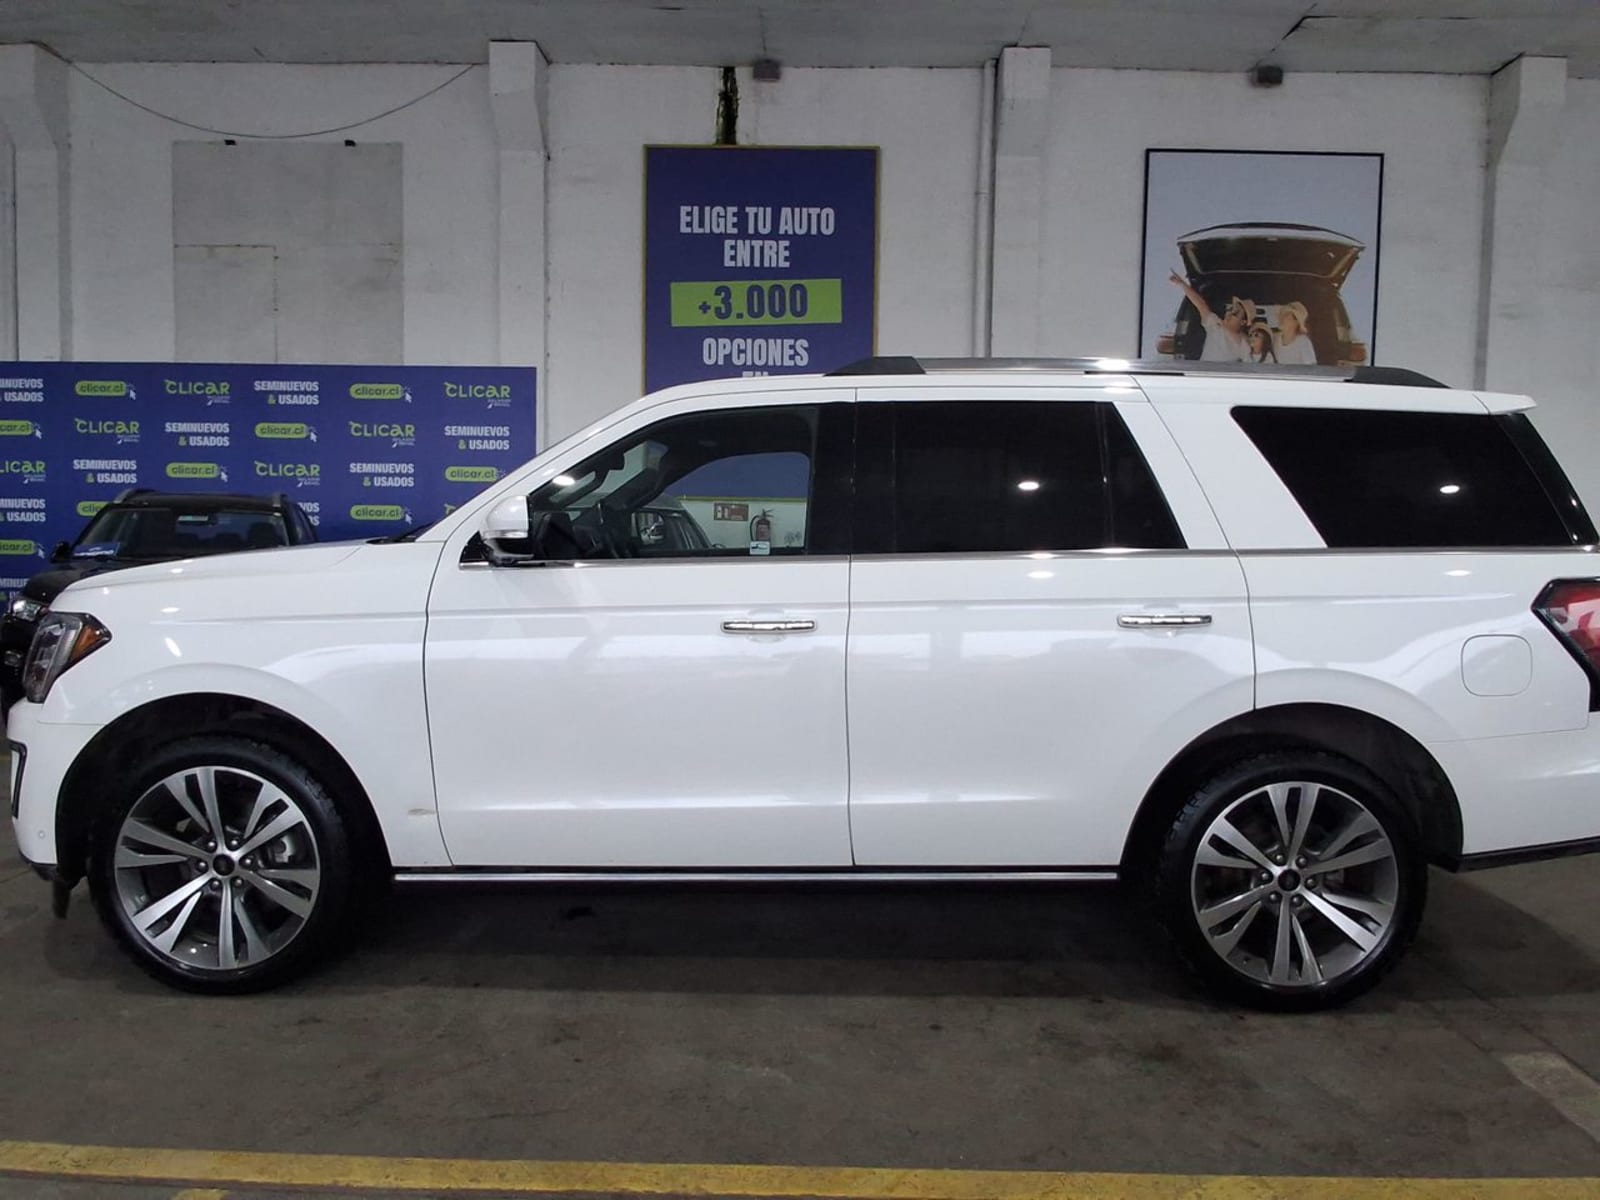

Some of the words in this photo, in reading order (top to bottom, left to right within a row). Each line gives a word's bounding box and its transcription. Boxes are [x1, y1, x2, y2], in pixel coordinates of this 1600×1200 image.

[679, 206, 738, 234] ELIGE
[745, 206, 772, 235] TU
[779, 207, 835, 235] AUTO
[723, 240, 790, 267] ENTRE
[698, 283, 808, 320] +3.000
[702, 338, 809, 367] OPCIONES
[254, 381, 319, 392] SEMINUEVOS
[354, 386, 399, 396] clicar.cl
[4, 391, 44, 402] USADOS
[278, 394, 319, 405] USADOS
[164, 422, 229, 433] SEMINUEVOS
[260, 426, 304, 436] clicar.cl
[444, 426, 509, 437] SEMINUEVOS
[189, 436, 229, 446] USADOS
[469, 440, 509, 450] USADOS
[73, 459, 137, 470] SEMINUEVOS
[171, 464, 216, 475] clicar.cl
[350, 462, 414, 474] SEMINUEVOS
[97, 473, 137, 484] USADOS
[450, 469, 494, 479] clicar.cl
[374, 477, 414, 487] USADOS
[6, 511, 46, 522] USADOS
[354, 508, 399, 518] clicar.cl
